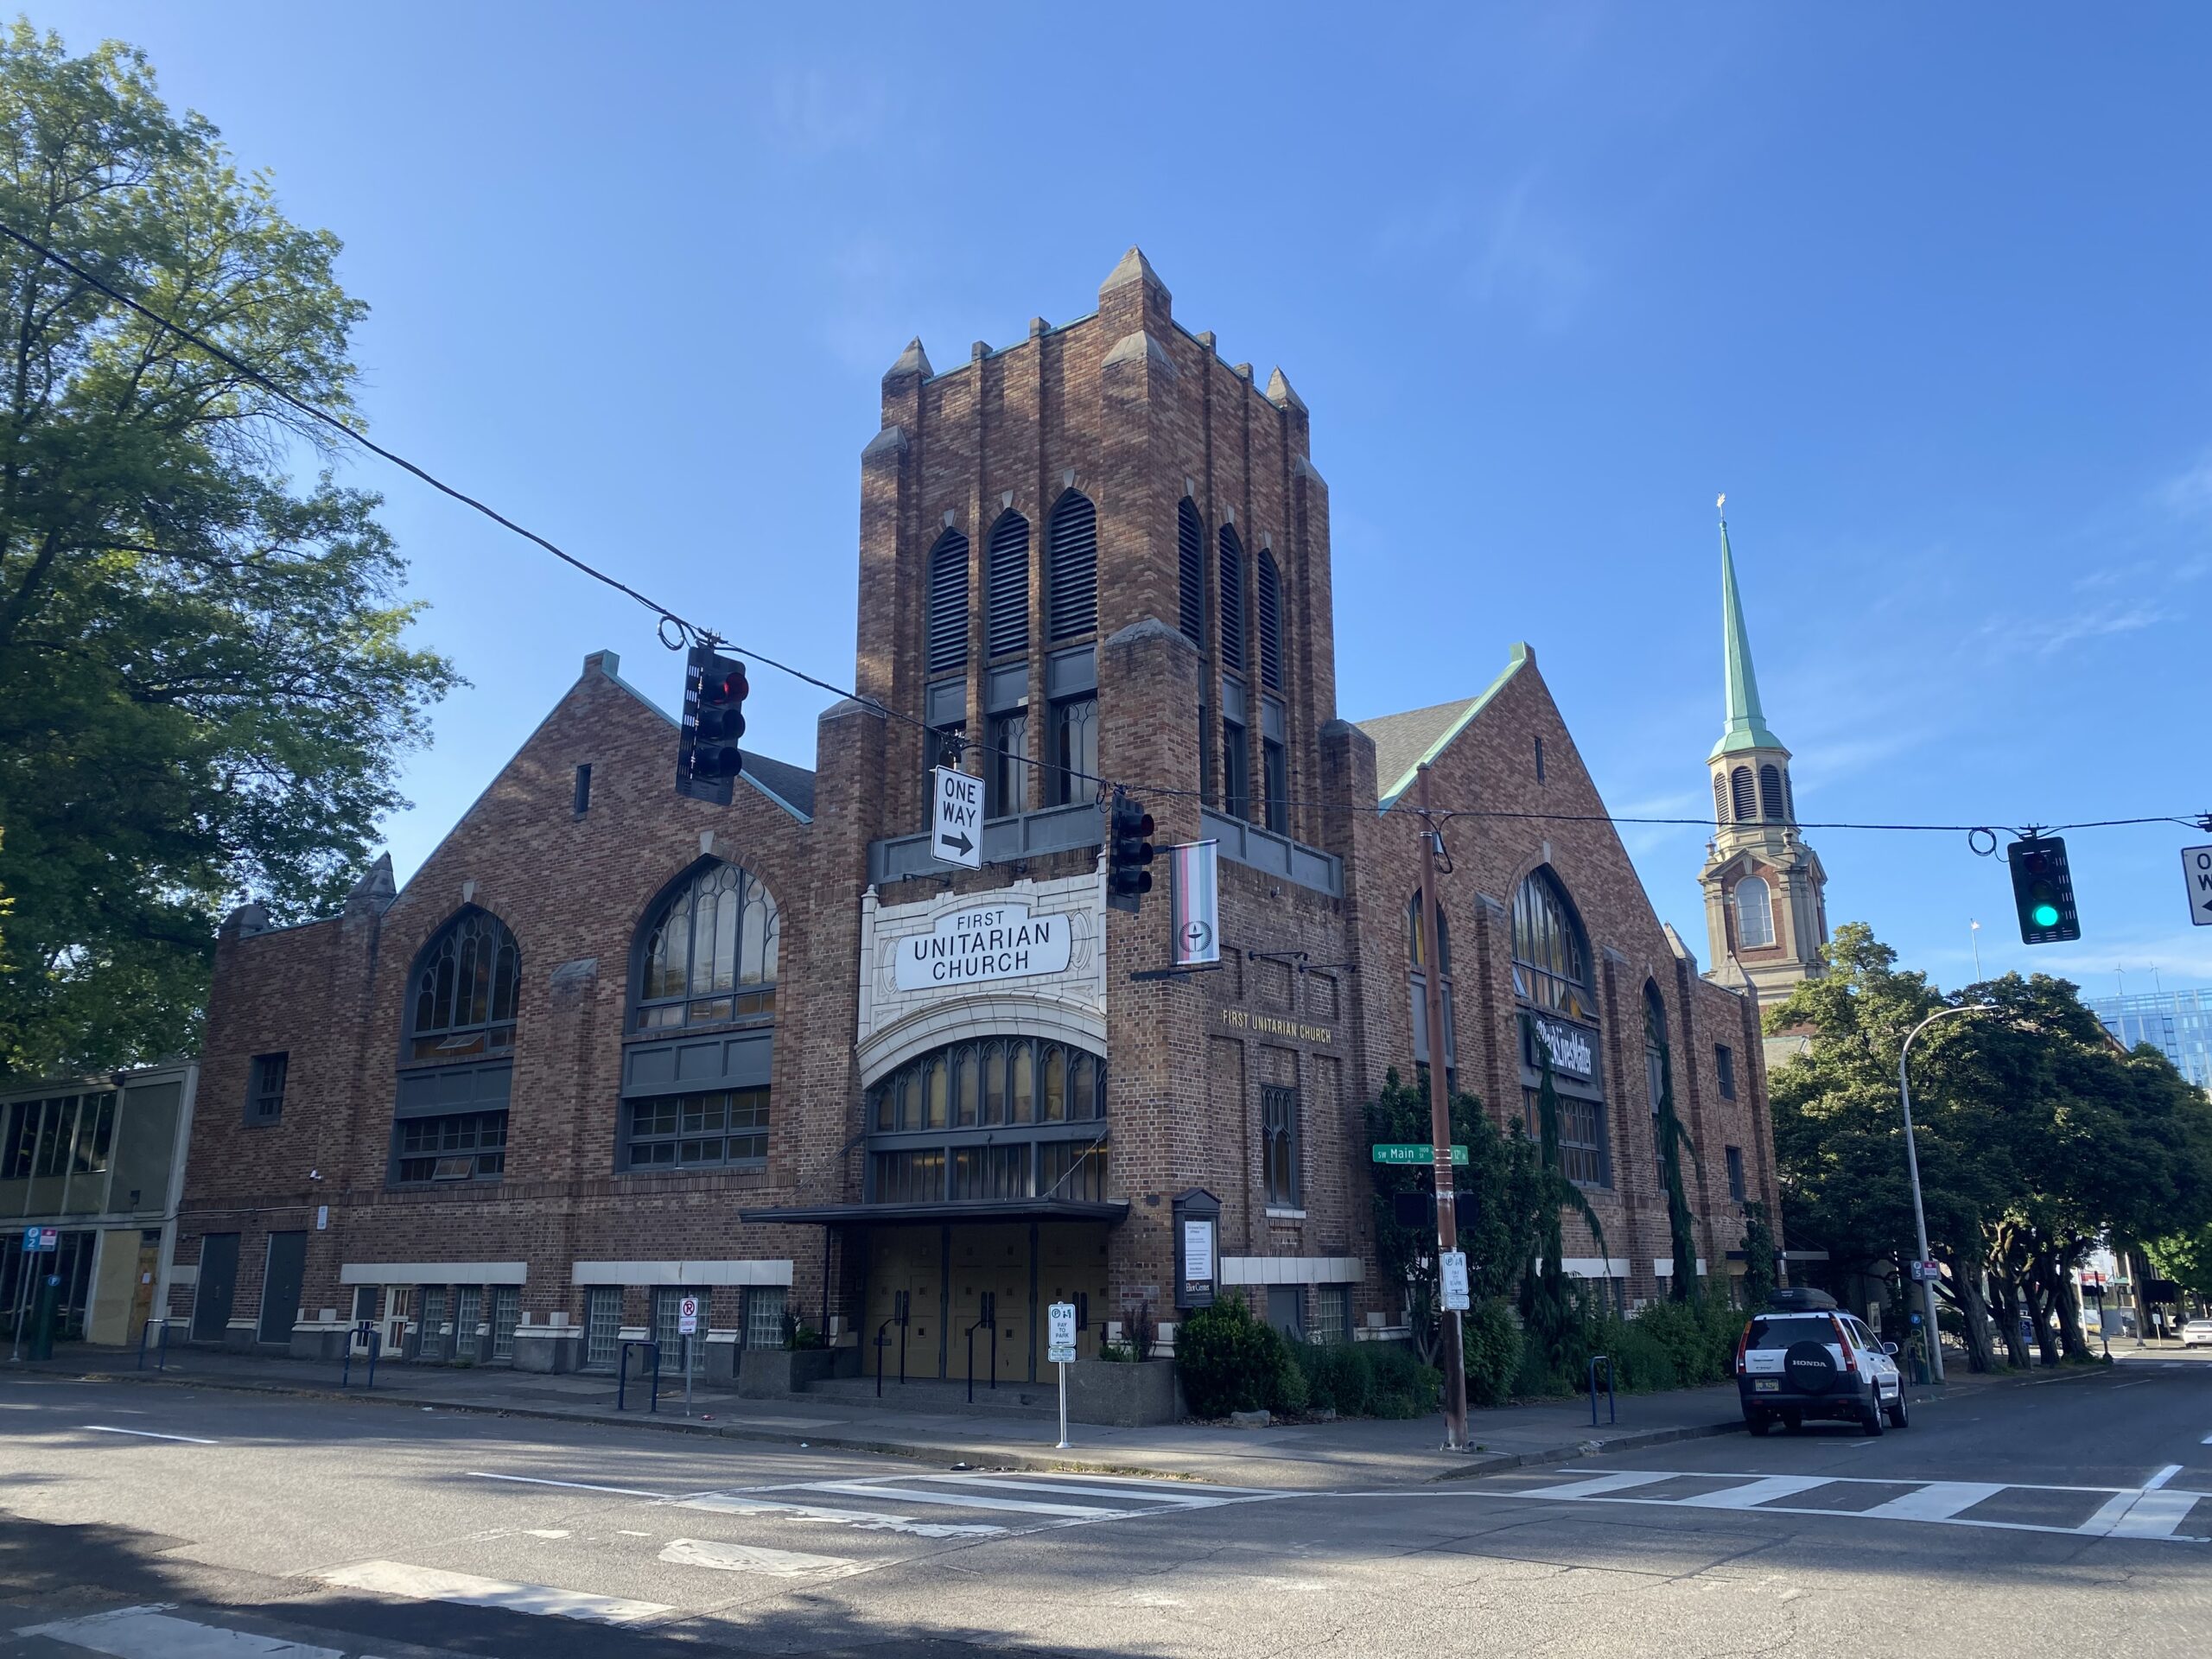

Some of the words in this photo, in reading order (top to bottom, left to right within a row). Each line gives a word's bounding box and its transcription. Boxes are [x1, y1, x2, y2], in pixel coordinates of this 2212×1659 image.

[945, 777, 976, 804] ONE
[943, 800, 976, 828] WAY
[957, 910, 1005, 931] FIRST
[914, 922, 1050, 961] UNITARIAN
[932, 950, 1029, 981] CHURCH
[1223, 1009, 1249, 1029] FIRST
[1252, 1015, 1297, 1038] UNITARIAN
[1300, 1024, 1332, 1044] CHURCH
[1390, 1147, 1414, 1159] Main
[28, 1238, 36, 1248] 2
[1195, 1282, 1211, 1292] Center
